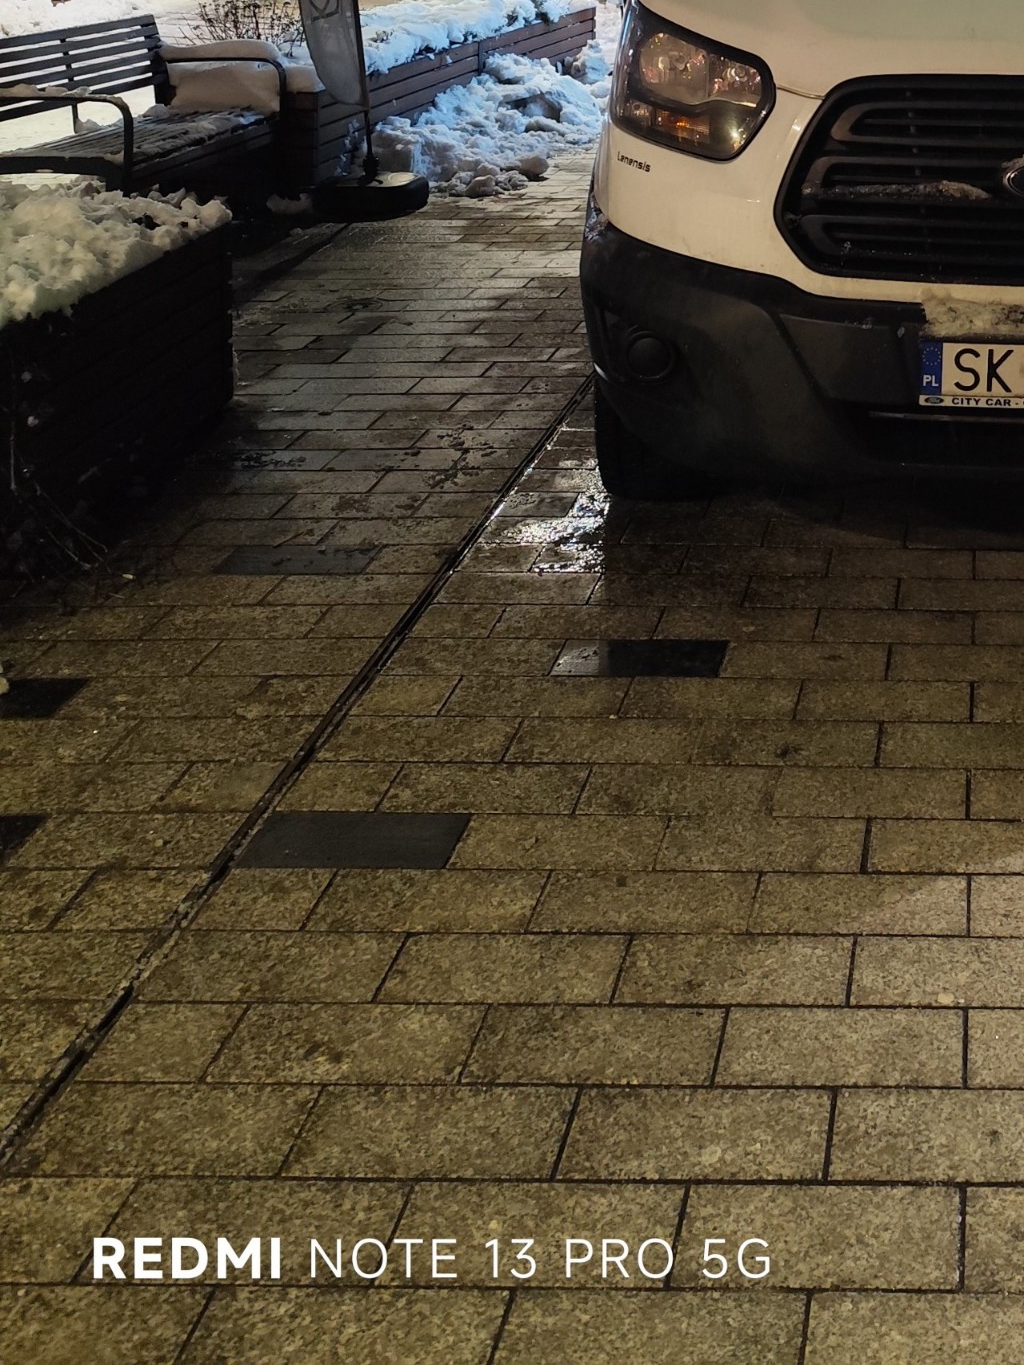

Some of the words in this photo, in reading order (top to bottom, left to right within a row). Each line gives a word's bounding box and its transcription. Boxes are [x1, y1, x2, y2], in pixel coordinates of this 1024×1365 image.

[923, 375, 939, 387] PL
[954, 348, 1014, 392] SK
[951, 397, 980, 406] CITY
[985, 398, 1011, 407] CAR
